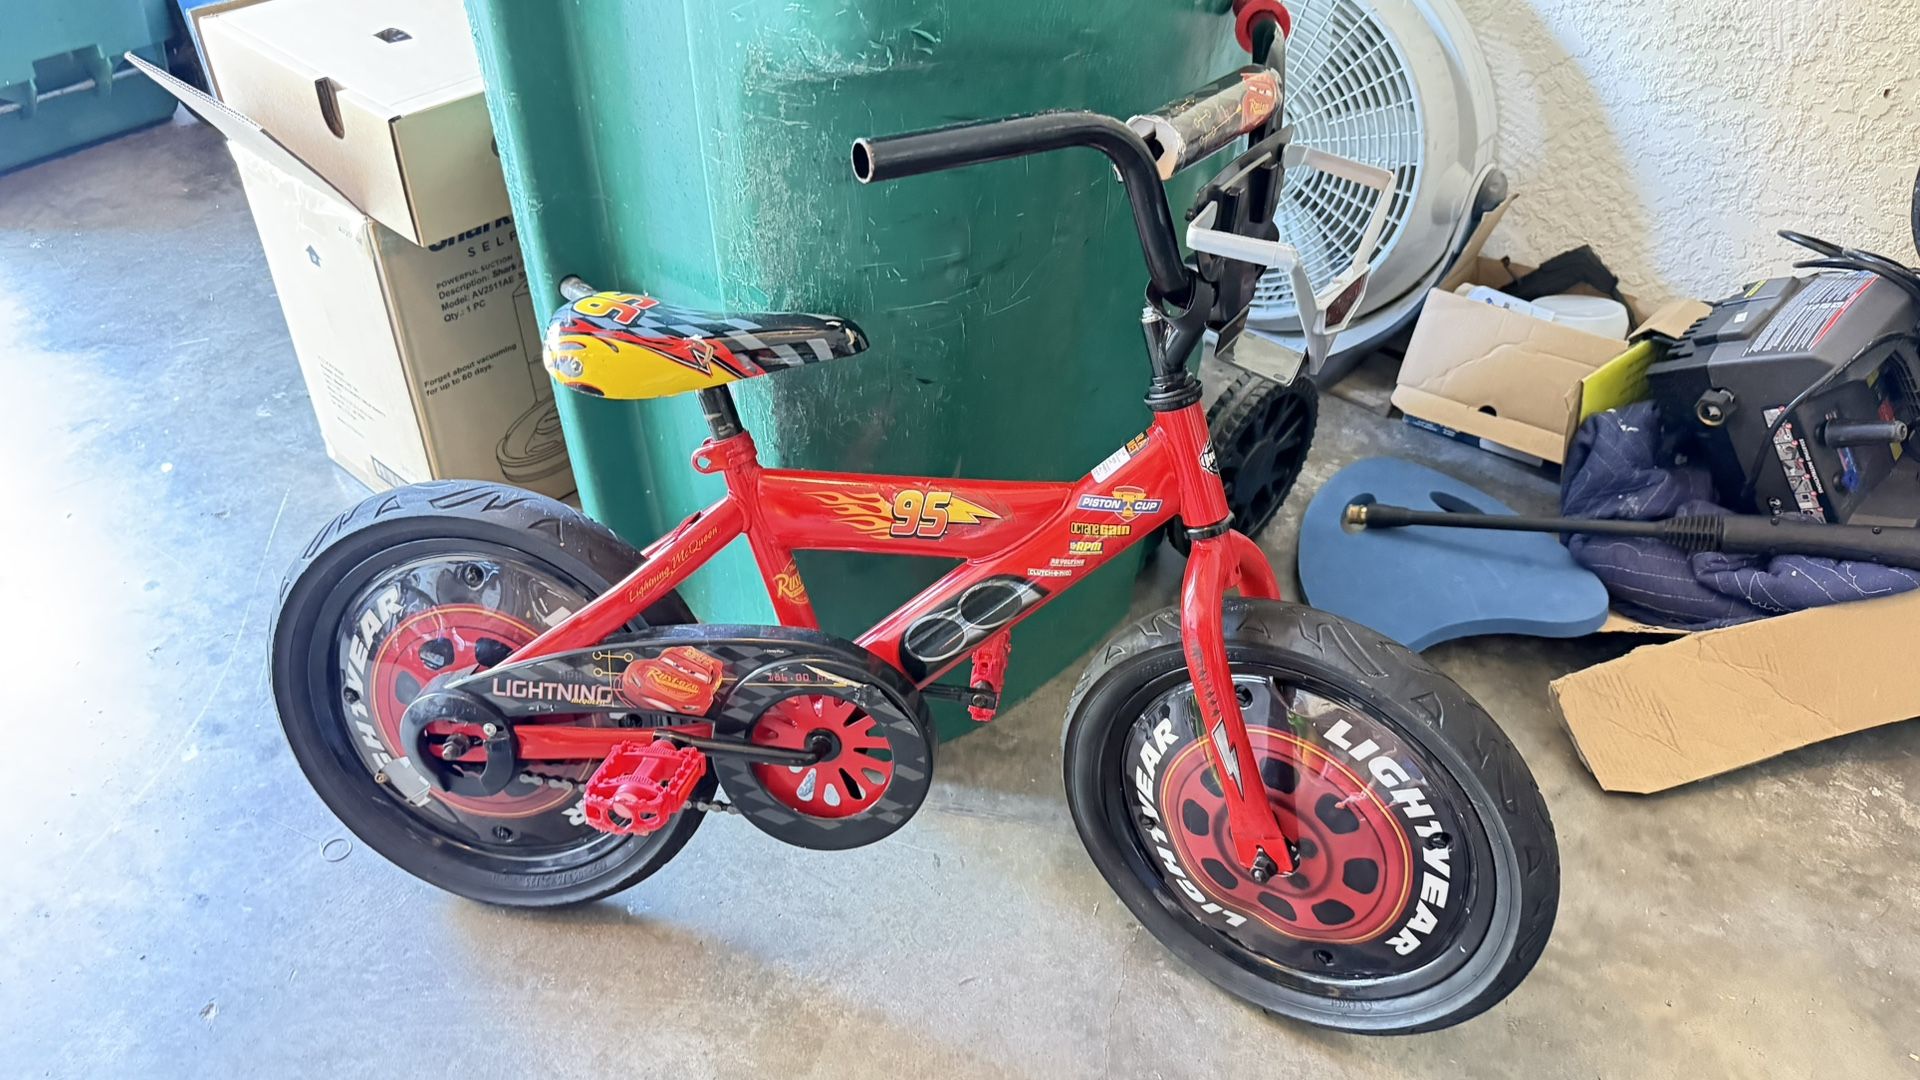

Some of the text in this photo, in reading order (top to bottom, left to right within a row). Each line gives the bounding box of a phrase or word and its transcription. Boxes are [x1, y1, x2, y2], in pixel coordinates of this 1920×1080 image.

[436, 255, 513, 290] POWERFUL SUCTION
[439, 276, 490, 300] Description:
[492, 263, 516, 278] Shark
[441, 275, 514, 312] Model: AV2511AE
[466, 305, 471, 313] 1
[473, 300, 486, 311] PC
[424, 343, 517, 388] Forget about vacuuming
[426, 387, 438, 397] for
[440, 382, 450, 391] up
[452, 378, 461, 386] to
[889, 489, 952, 540] 95
[1082, 497, 1157, 510] PISTON CUP
[629, 526, 718, 602] Lightning McQueen
[492, 678, 613, 704] LIGHTNING
[1323, 719, 1451, 956] LIGHTYEAR
